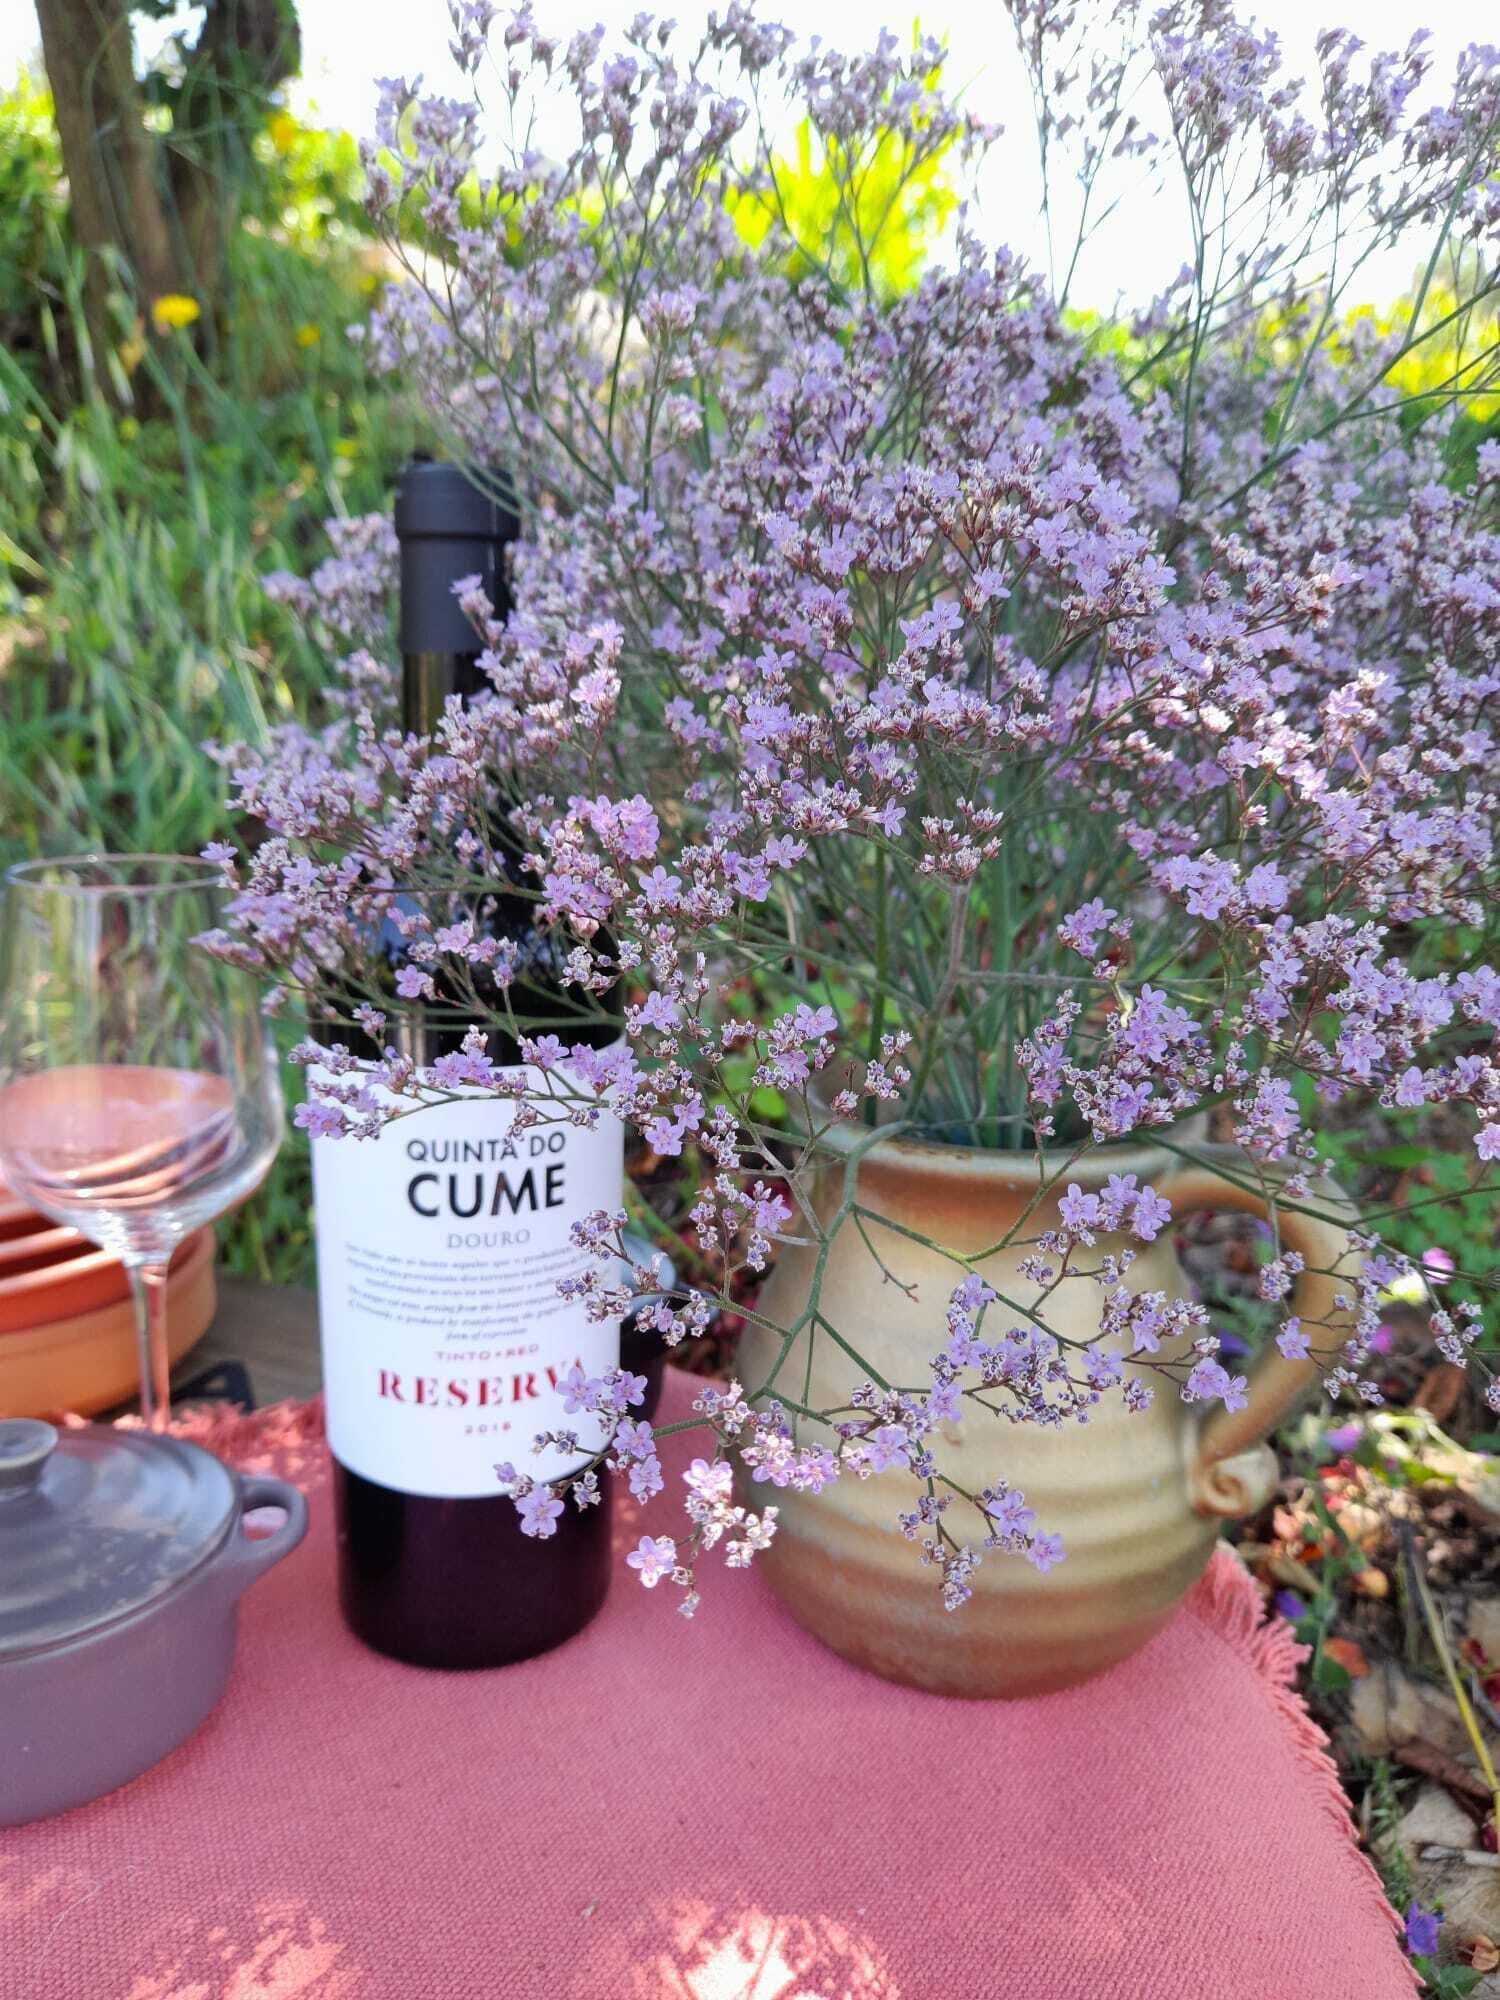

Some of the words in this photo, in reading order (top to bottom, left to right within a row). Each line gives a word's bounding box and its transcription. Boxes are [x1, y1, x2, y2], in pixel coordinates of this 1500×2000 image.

[406, 1138, 518, 1163] QUINTA
[529, 1131, 567, 1157] DO
[407, 1163, 566, 1218] CUME
[448, 1229, 531, 1249] DOURO
[379, 1356, 586, 1408] RESERV
